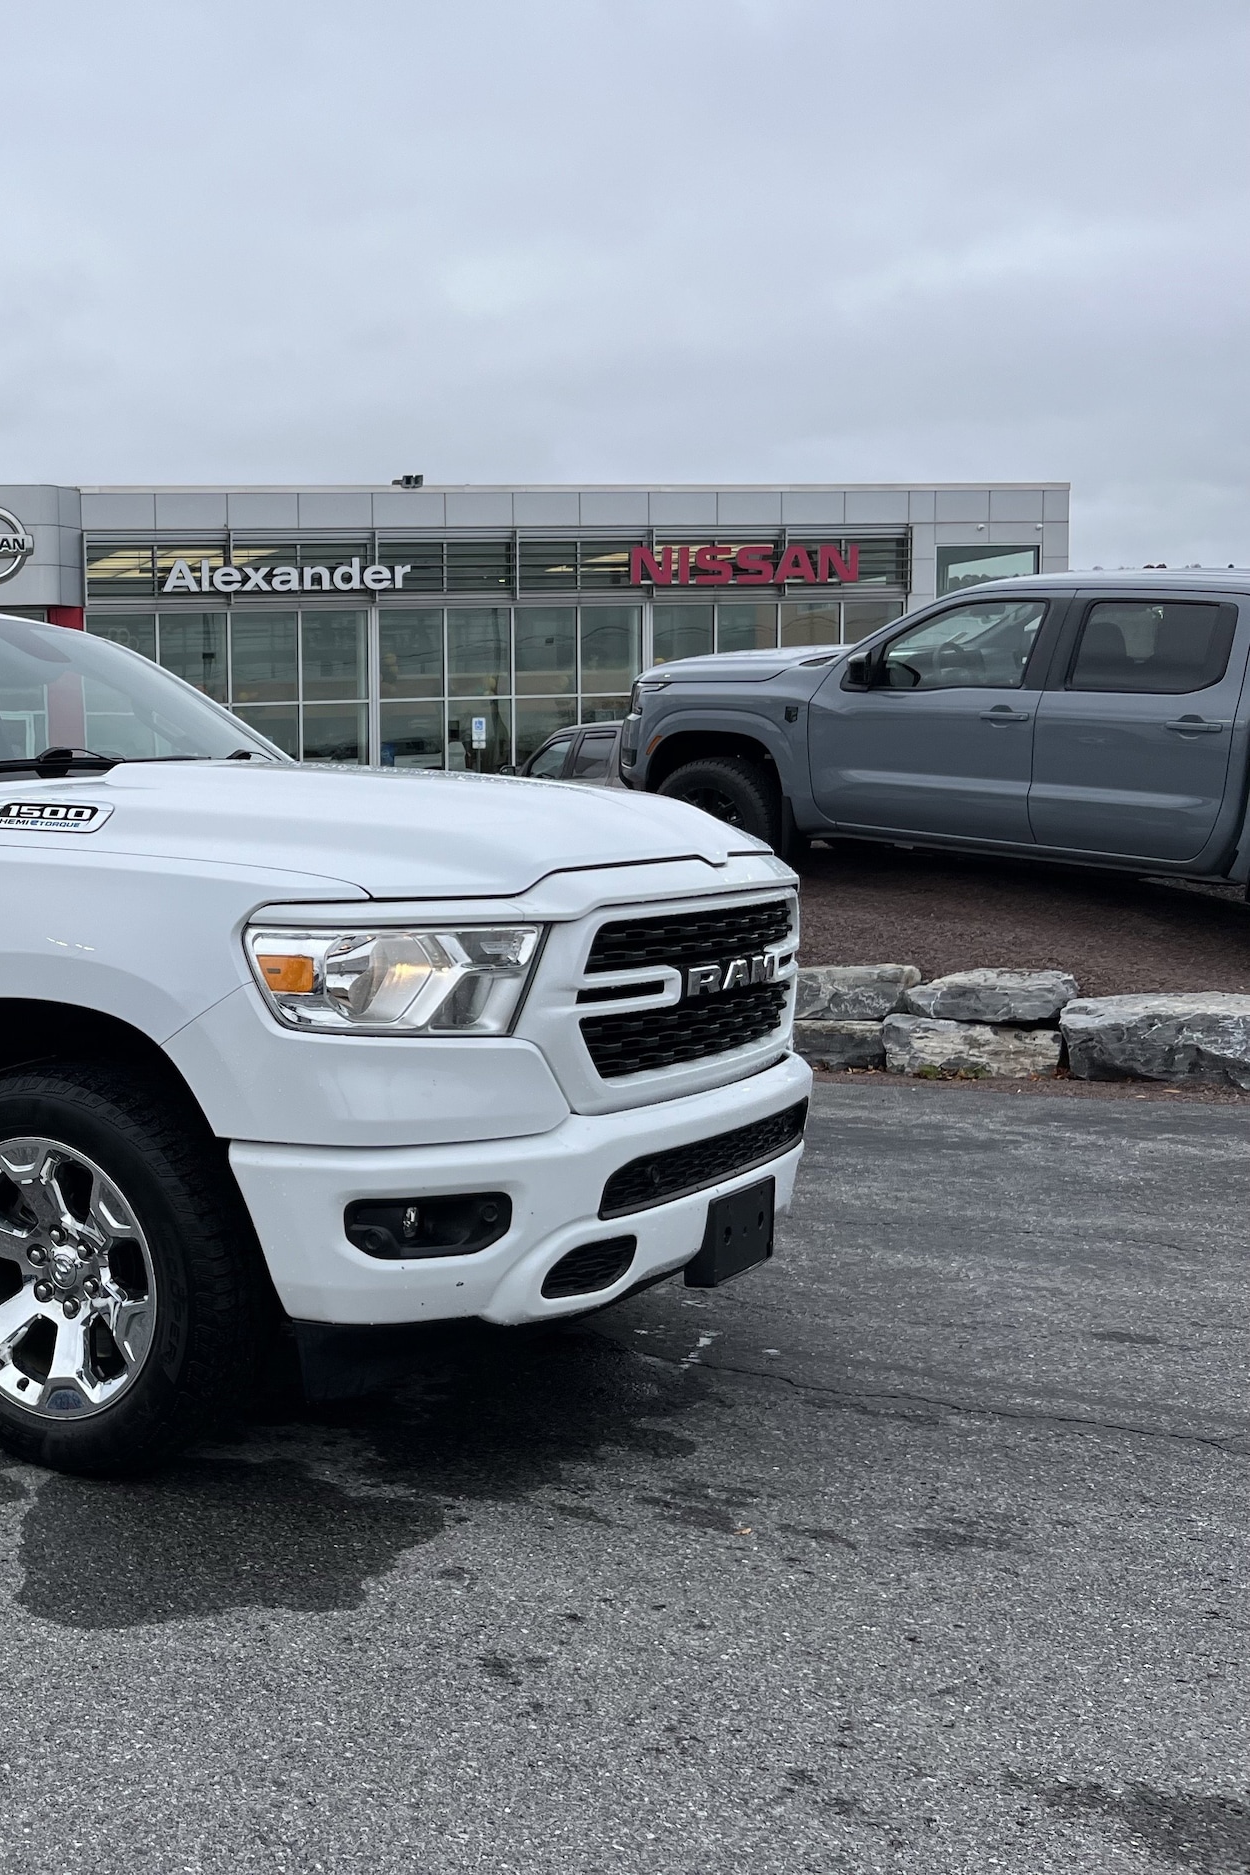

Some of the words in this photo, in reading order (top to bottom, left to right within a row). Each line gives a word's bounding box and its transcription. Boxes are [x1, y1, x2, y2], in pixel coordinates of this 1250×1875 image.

[162, 557, 412, 593] Alexander
[631, 545, 860, 585] NISSAN
[8, 805, 92, 820] 1500
[687, 953, 775, 997] RAM
